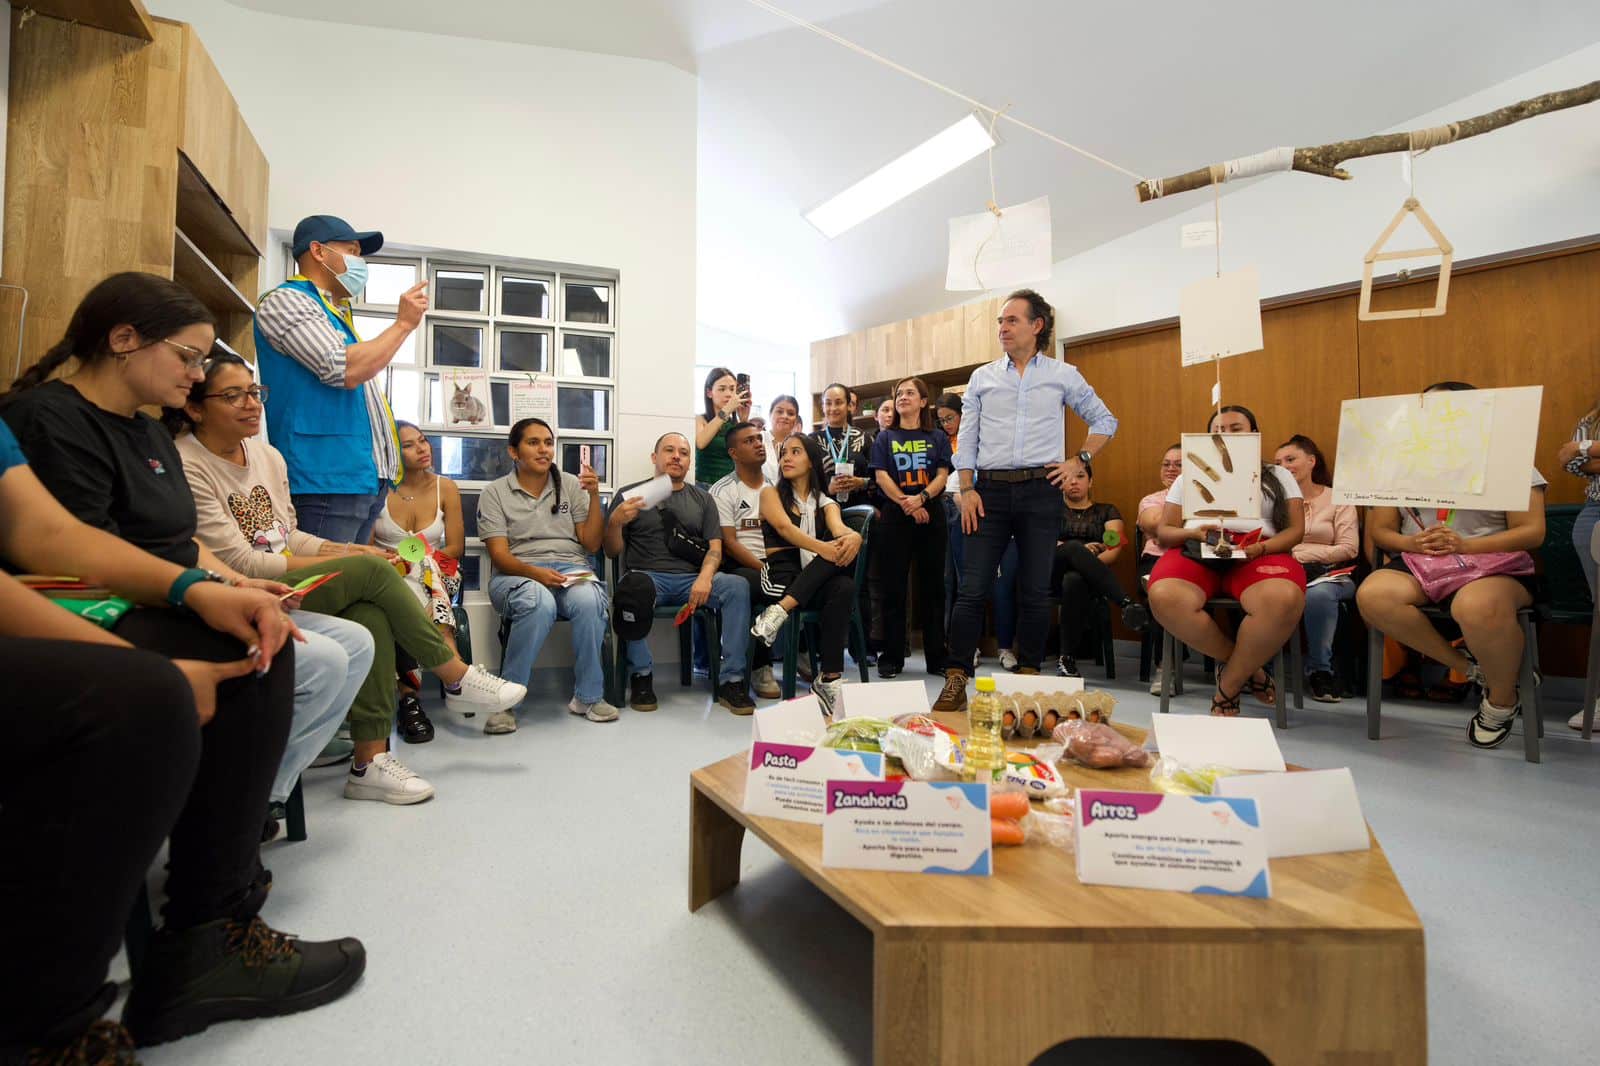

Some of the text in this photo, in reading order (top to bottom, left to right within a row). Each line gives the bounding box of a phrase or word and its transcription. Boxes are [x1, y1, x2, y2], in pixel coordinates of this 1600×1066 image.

[892, 440, 932, 453] ME-
[894, 453, 932, 470] DE-
[764, 751, 797, 768] Pasta
[834, 790, 906, 809] Zanahoria
[1090, 800, 1137, 820] Arroz
